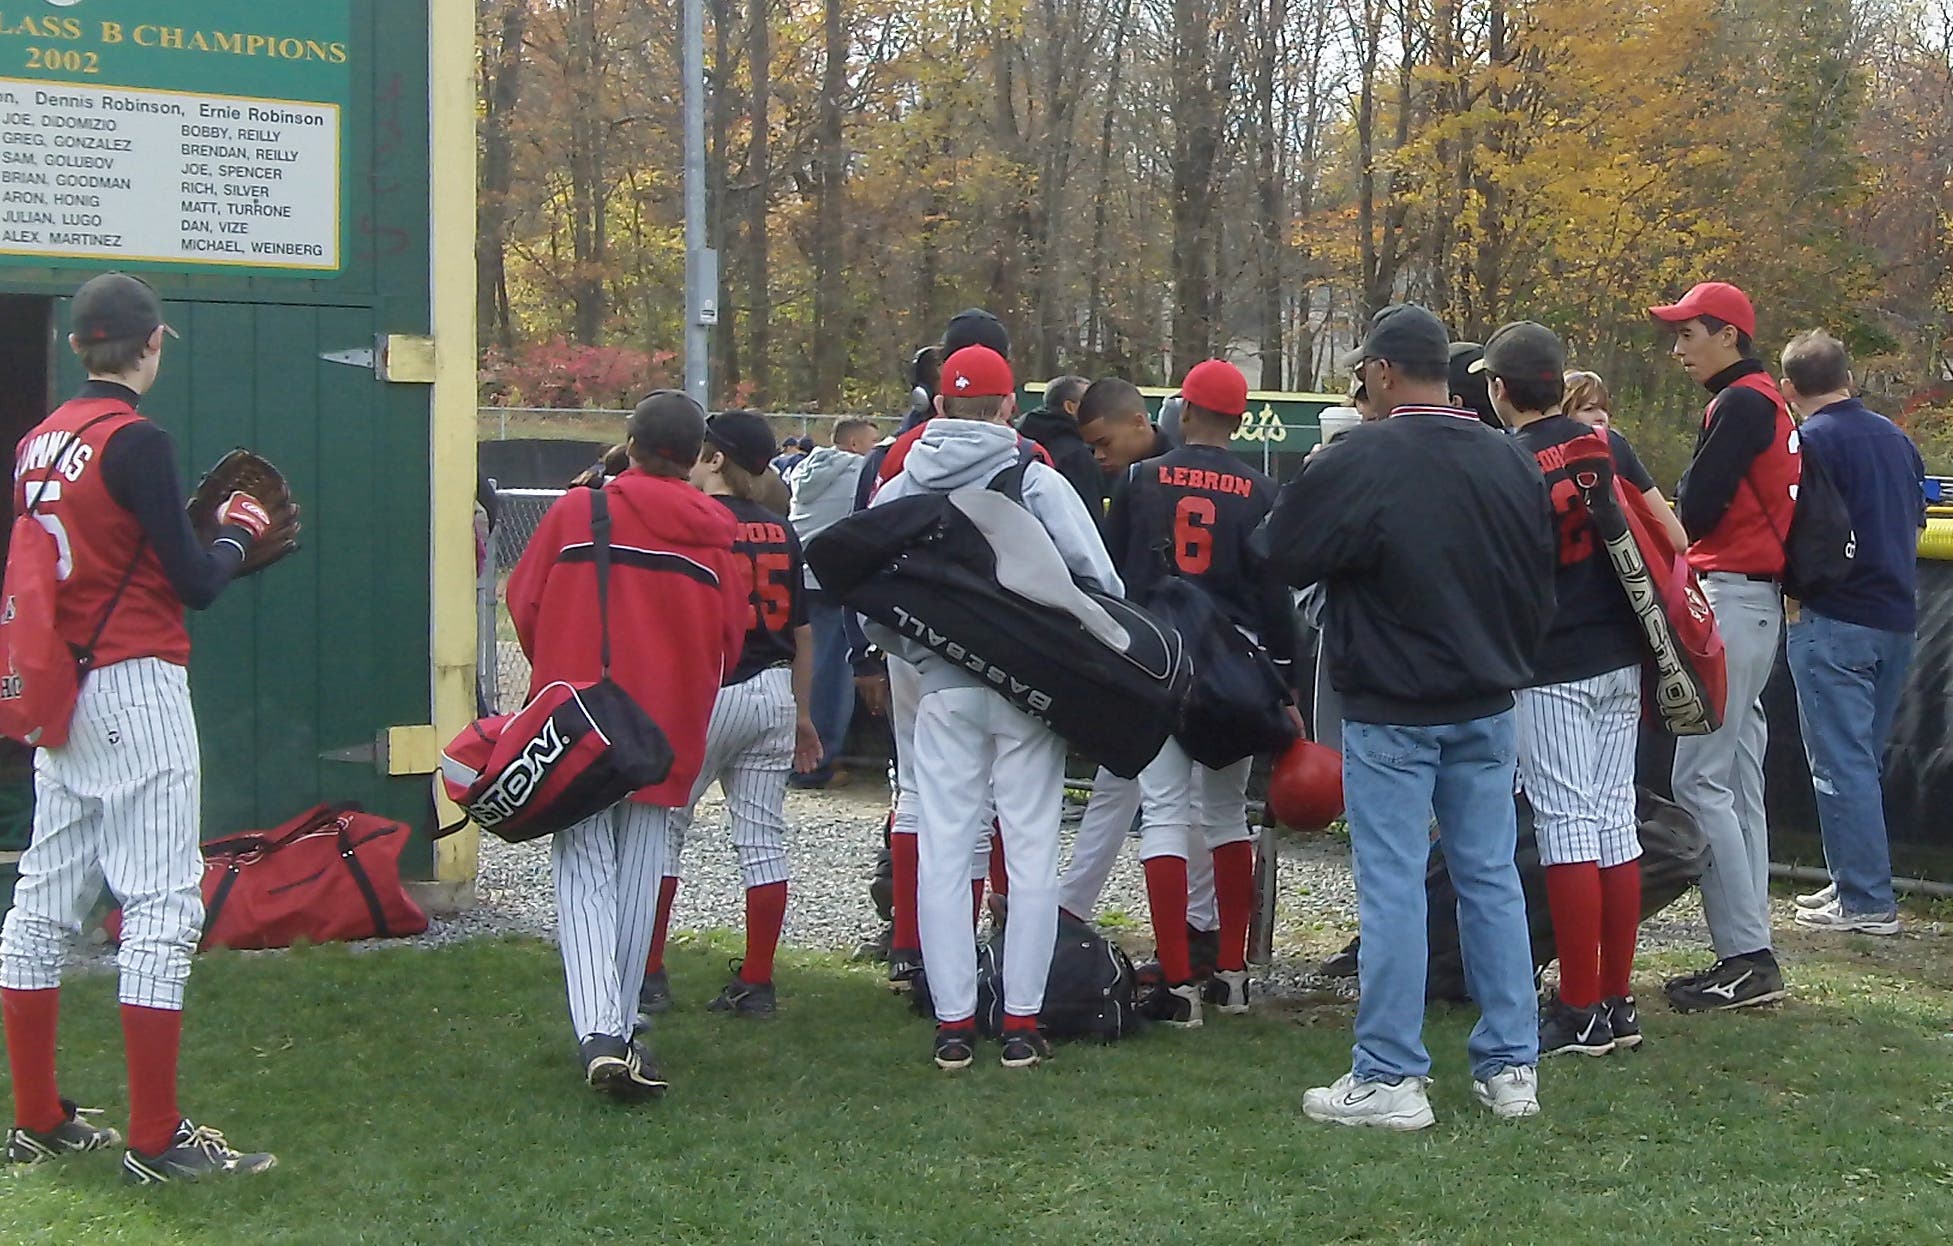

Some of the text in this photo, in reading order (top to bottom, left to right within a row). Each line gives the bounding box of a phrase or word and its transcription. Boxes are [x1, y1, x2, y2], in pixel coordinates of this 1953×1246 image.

[101, 22, 123, 43] B
[133, 24, 347, 63] CHAMPIONS
[25, 47, 99, 73] 2002
[35, 91, 93, 108] Dennis
[102, 96, 185, 117] Robinson,
[199, 104, 240, 119] Ernie
[248, 107, 324, 126] Robinson
[181, 124, 281, 142] BOBBY, REILLY
[54, 135, 132, 151] GONZALEZ
[181, 143, 299, 162] BRENDAN, REILLY
[181, 163, 282, 180] JOE, SPENCER
[55, 174, 131, 190] GOODMAN
[181, 181, 269, 197] RICH, SILVER
[54, 193, 100, 207] HONIG
[181, 200, 291, 218] MATT, TURRONE
[62, 213, 102, 227] LUGO
[181, 219, 249, 234] DAN, VIZE
[49, 232, 122, 247] MARTINEZ
[181, 238, 323, 256] MICHAEL, WEINBERG
[1158, 465, 1253, 498] LEBRON
[1174, 495, 1216, 575] 6
[1604, 529, 1713, 736] EASTON
[893, 606, 1052, 711] BASEBALL
